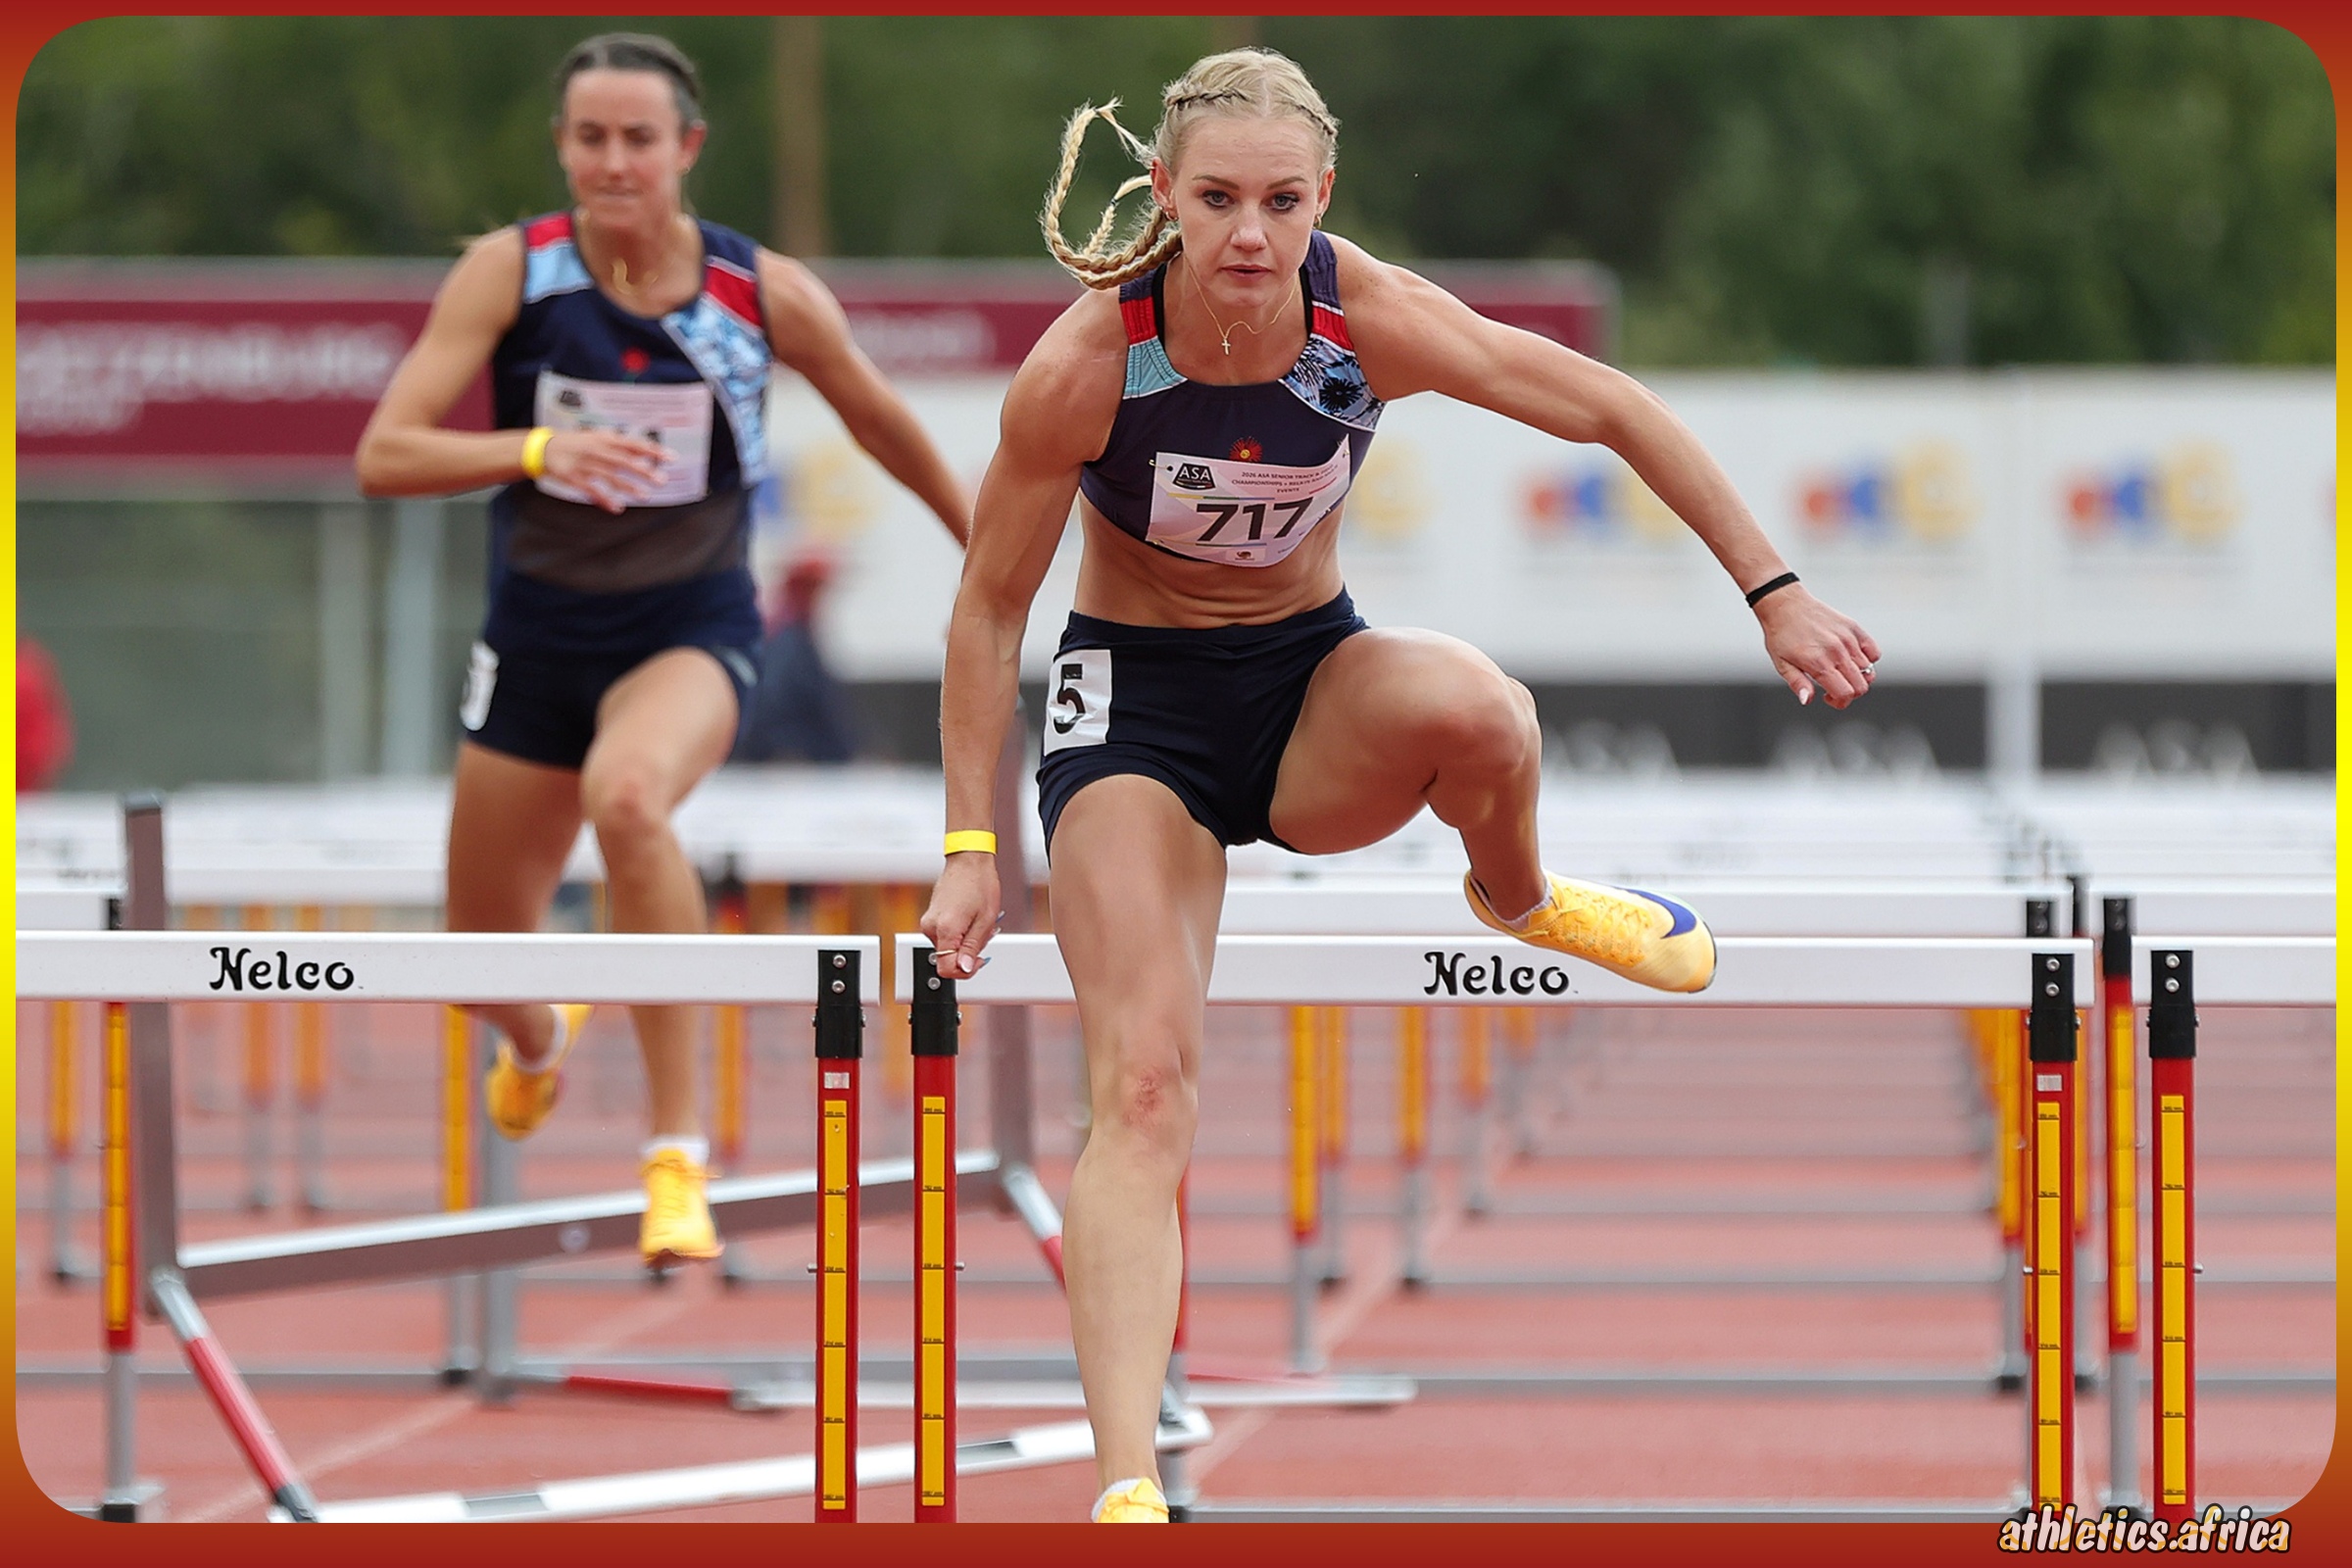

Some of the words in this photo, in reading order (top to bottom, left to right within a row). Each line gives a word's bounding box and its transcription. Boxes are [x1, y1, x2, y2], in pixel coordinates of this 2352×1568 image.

[1179, 466, 1210, 481] ASA
[1196, 497, 1313, 541] 717
[1053, 663, 1086, 734] 5
[209, 947, 355, 991] Nelco
[1424, 952, 1570, 996] Nelco
